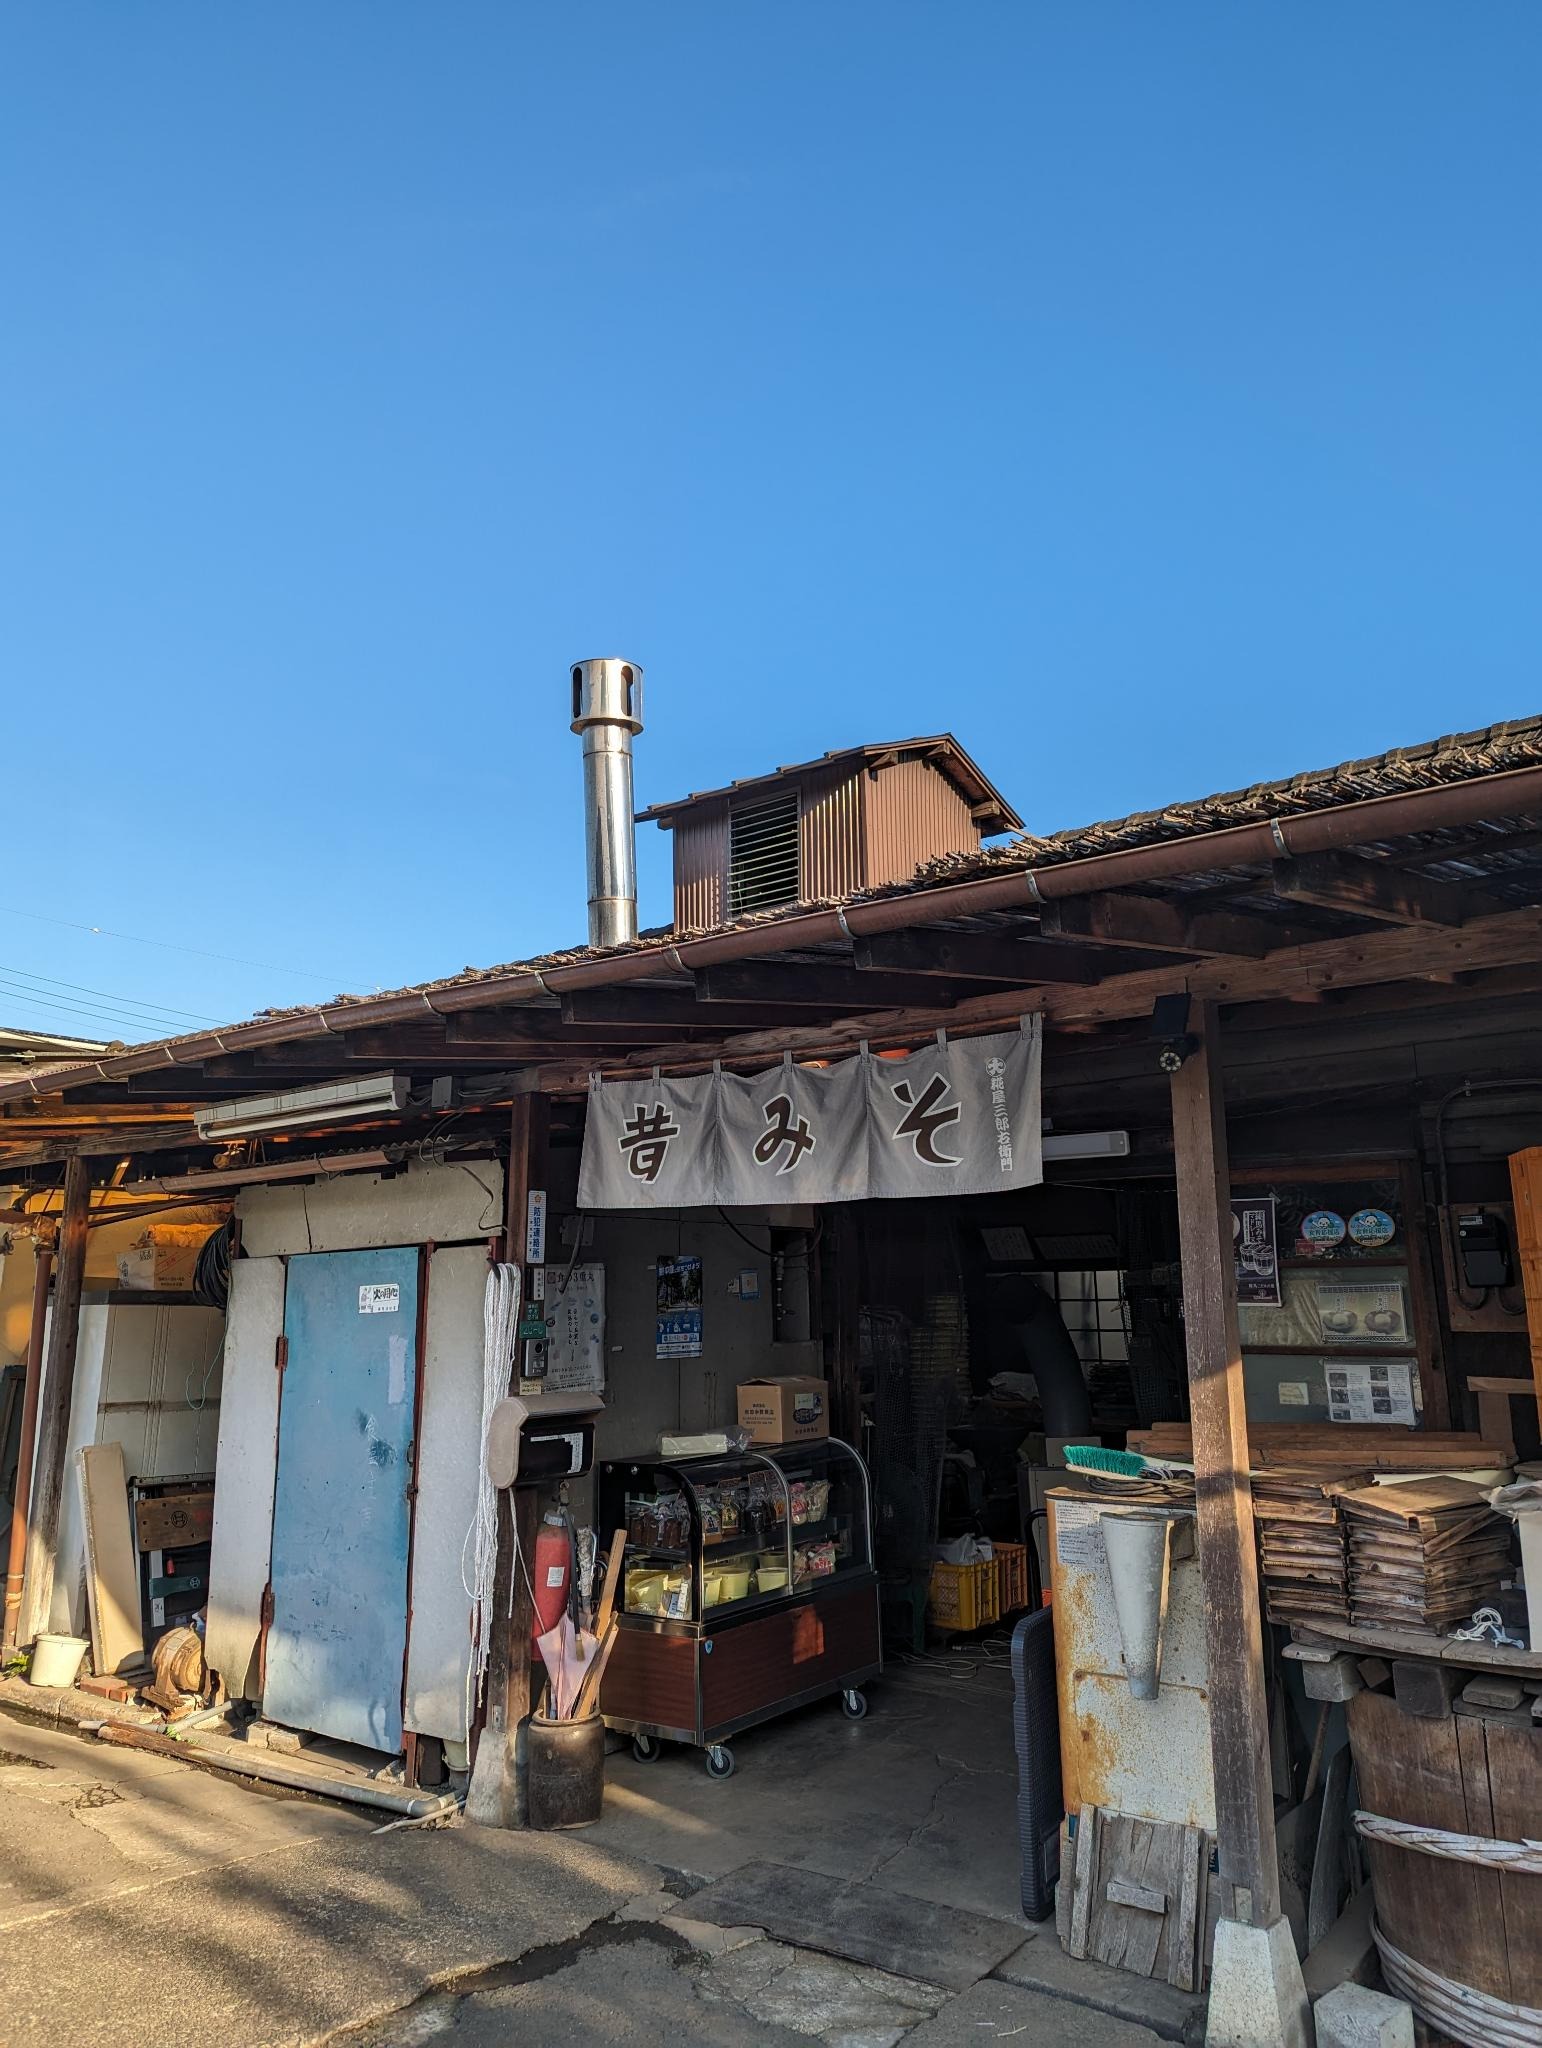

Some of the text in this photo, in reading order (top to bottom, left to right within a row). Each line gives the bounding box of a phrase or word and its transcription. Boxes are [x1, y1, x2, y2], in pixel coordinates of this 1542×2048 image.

[532, 1206, 542, 1259] 防犯連絡所
[373, 1287, 398, 1300] 火の用心
